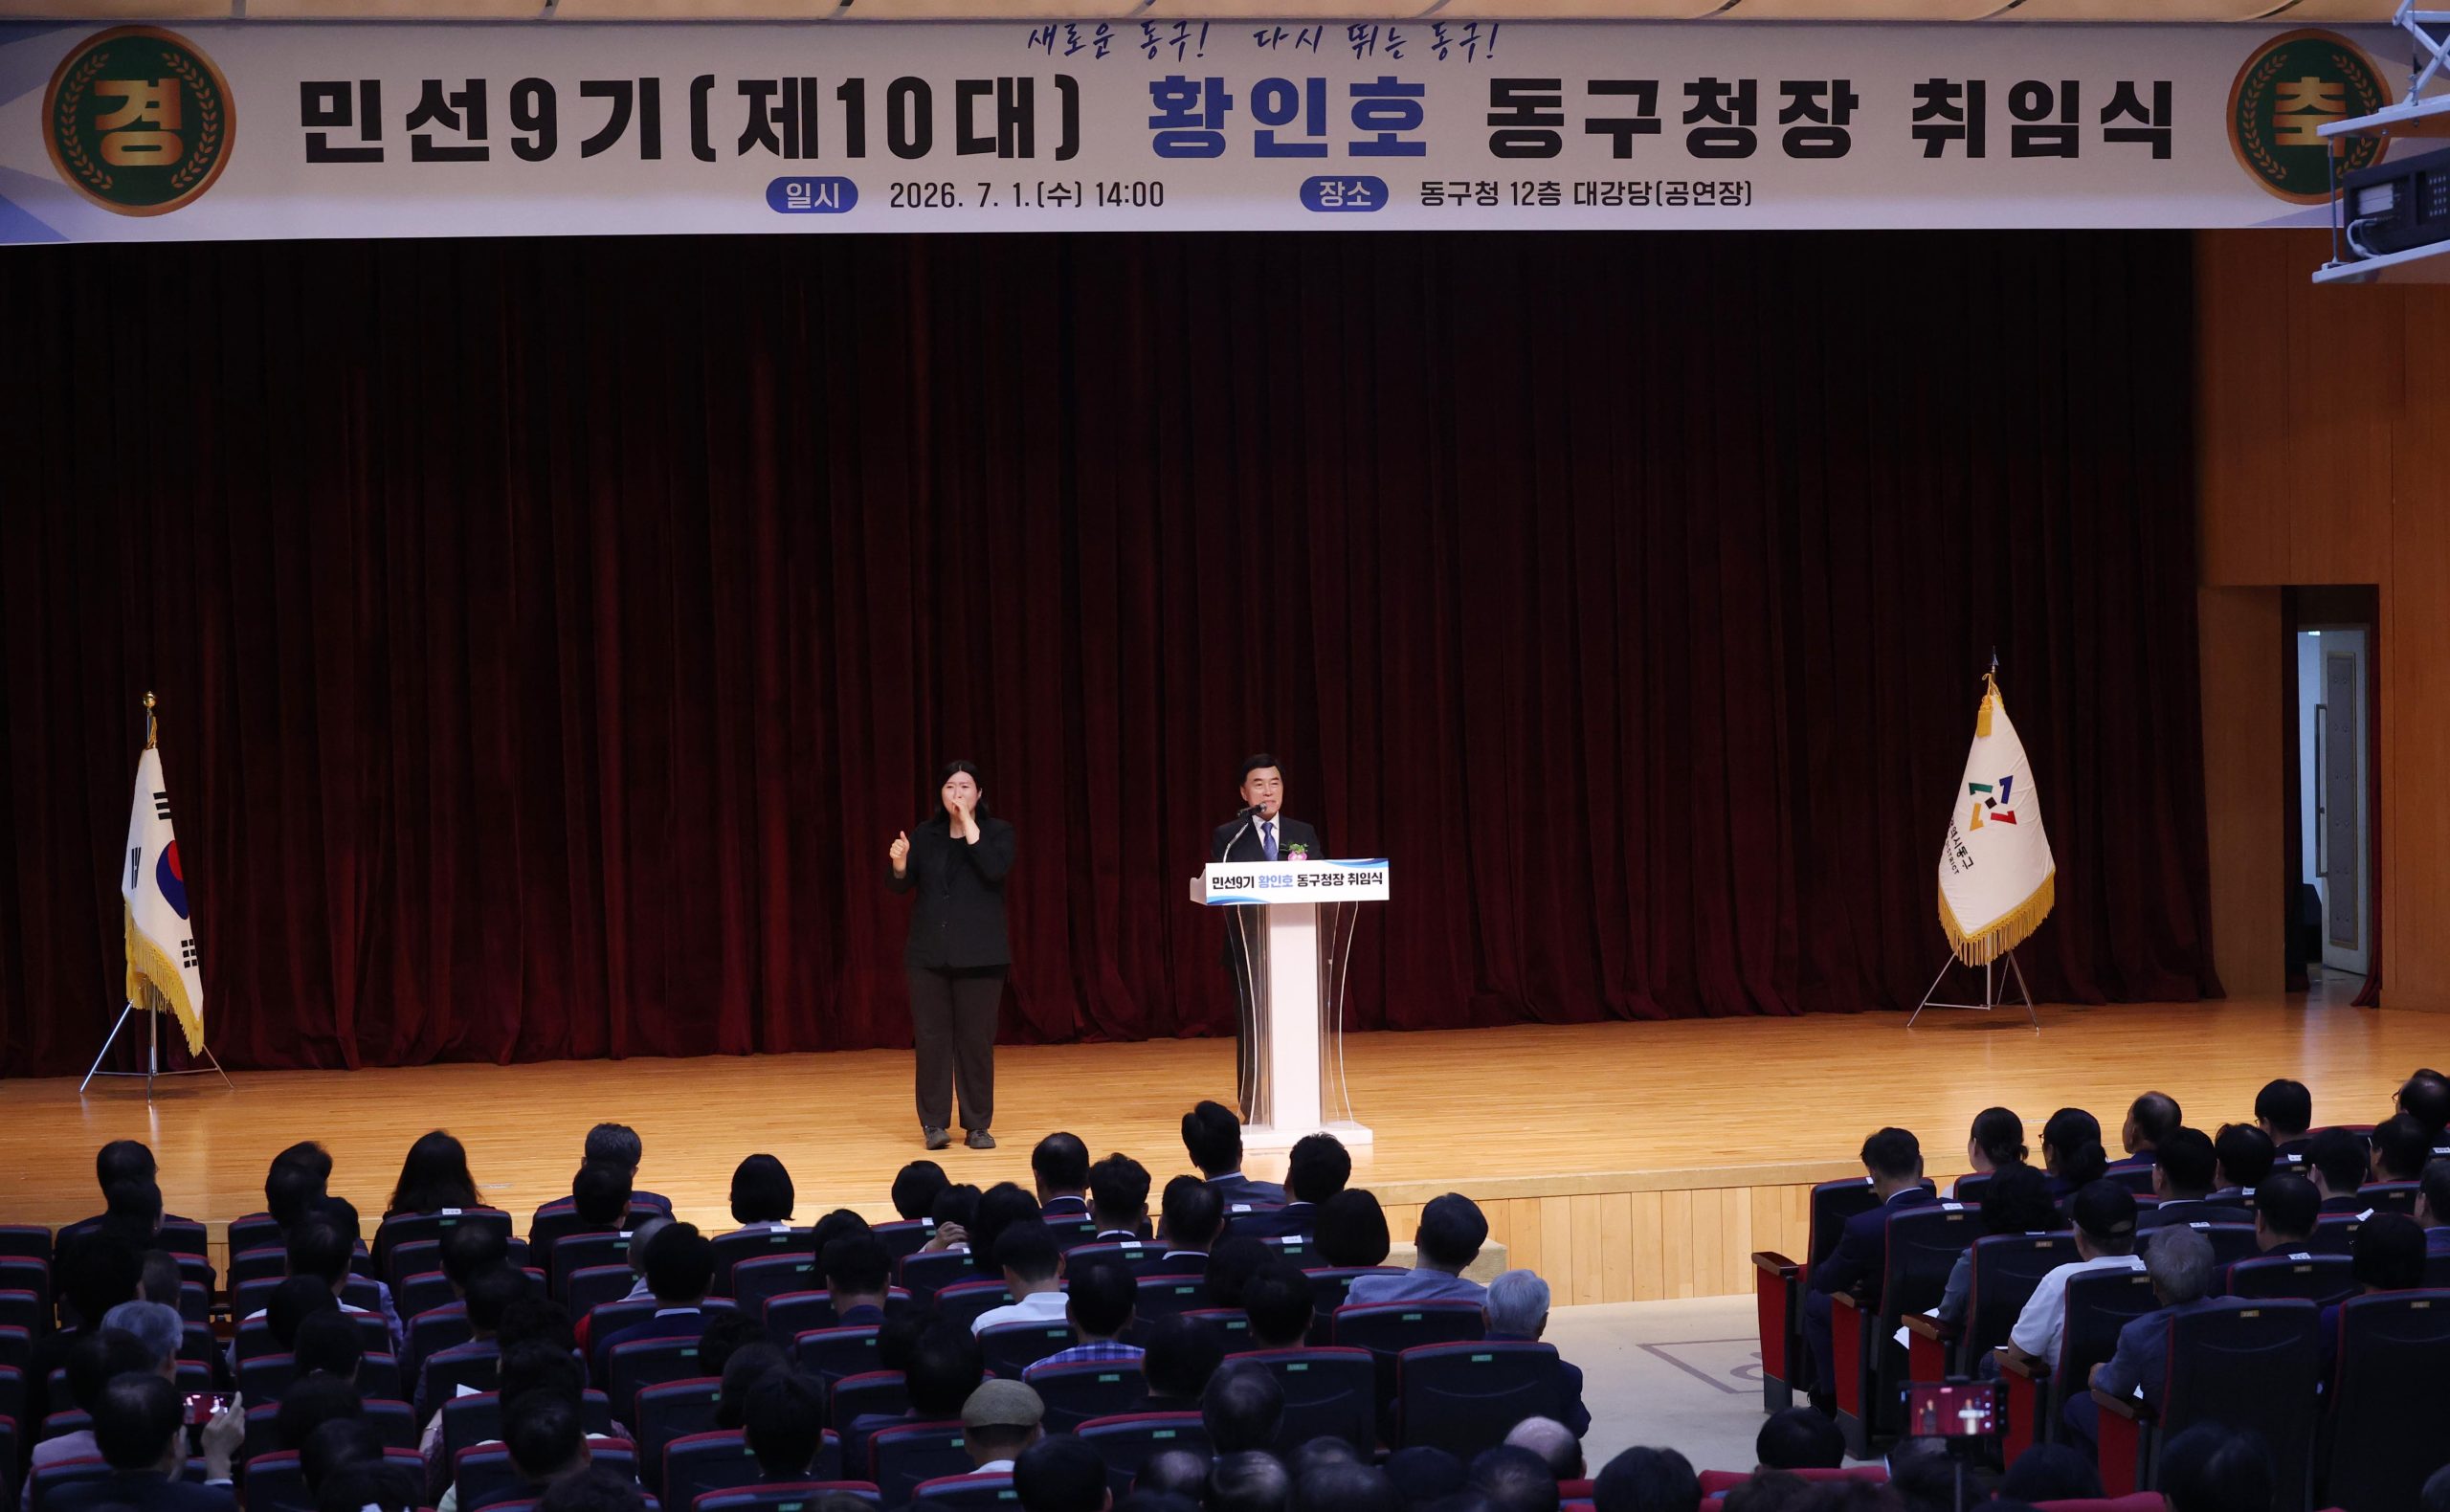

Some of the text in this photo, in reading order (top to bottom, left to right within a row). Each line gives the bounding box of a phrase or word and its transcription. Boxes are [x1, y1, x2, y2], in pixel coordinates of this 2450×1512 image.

[1028, 22, 1500, 62] 새로운 동구! 다시 뛰는 동구!
[94, 77, 185, 167] 경
[1148, 75, 1427, 159] 황인호
[1486, 77, 1860, 160] 동구청장
[1911, 78, 2172, 160] 취임식
[2272, 77, 2348, 158] 축
[786, 182, 839, 210] 일시
[890, 182, 963, 209] 2026.
[977, 182, 998, 208] 7.
[1096, 181, 1164, 208] 14:00
[1319, 181, 1372, 207] 장소
[1420, 180, 1499, 207] 동구청
[1510, 180, 1562, 207] 12층
[1212, 876, 1255, 890] 민선9기
[1297, 873, 1345, 888] 동구청장
[1348, 872, 1383, 886] 취임식
